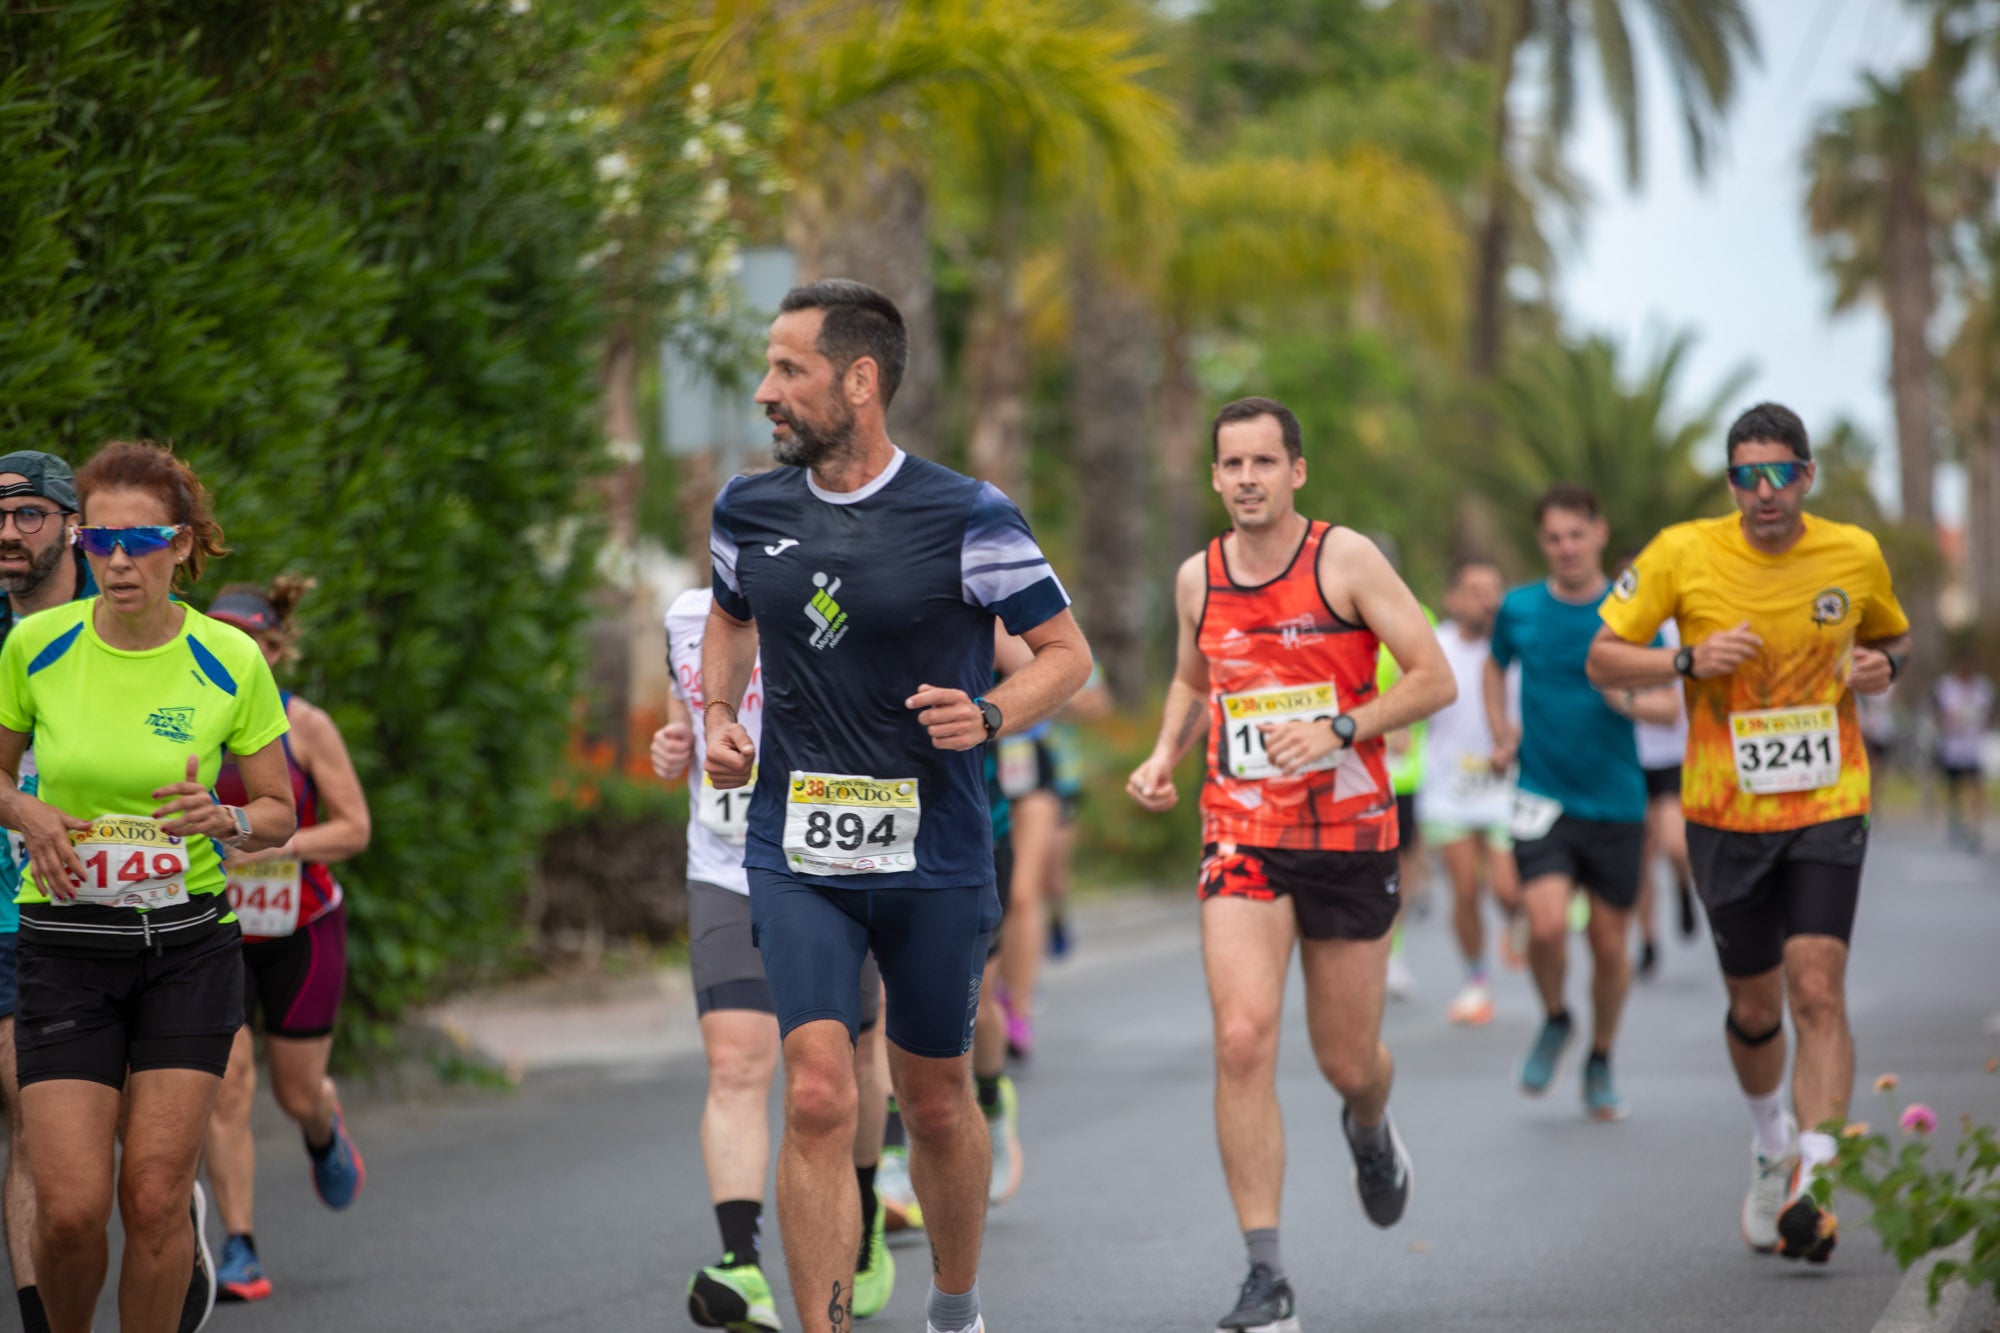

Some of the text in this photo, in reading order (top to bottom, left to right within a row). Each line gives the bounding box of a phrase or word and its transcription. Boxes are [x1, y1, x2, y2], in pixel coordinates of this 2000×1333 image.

[1739, 732, 1831, 772] 3241
[806, 779, 825, 797] 38
[805, 811, 898, 852] 894
